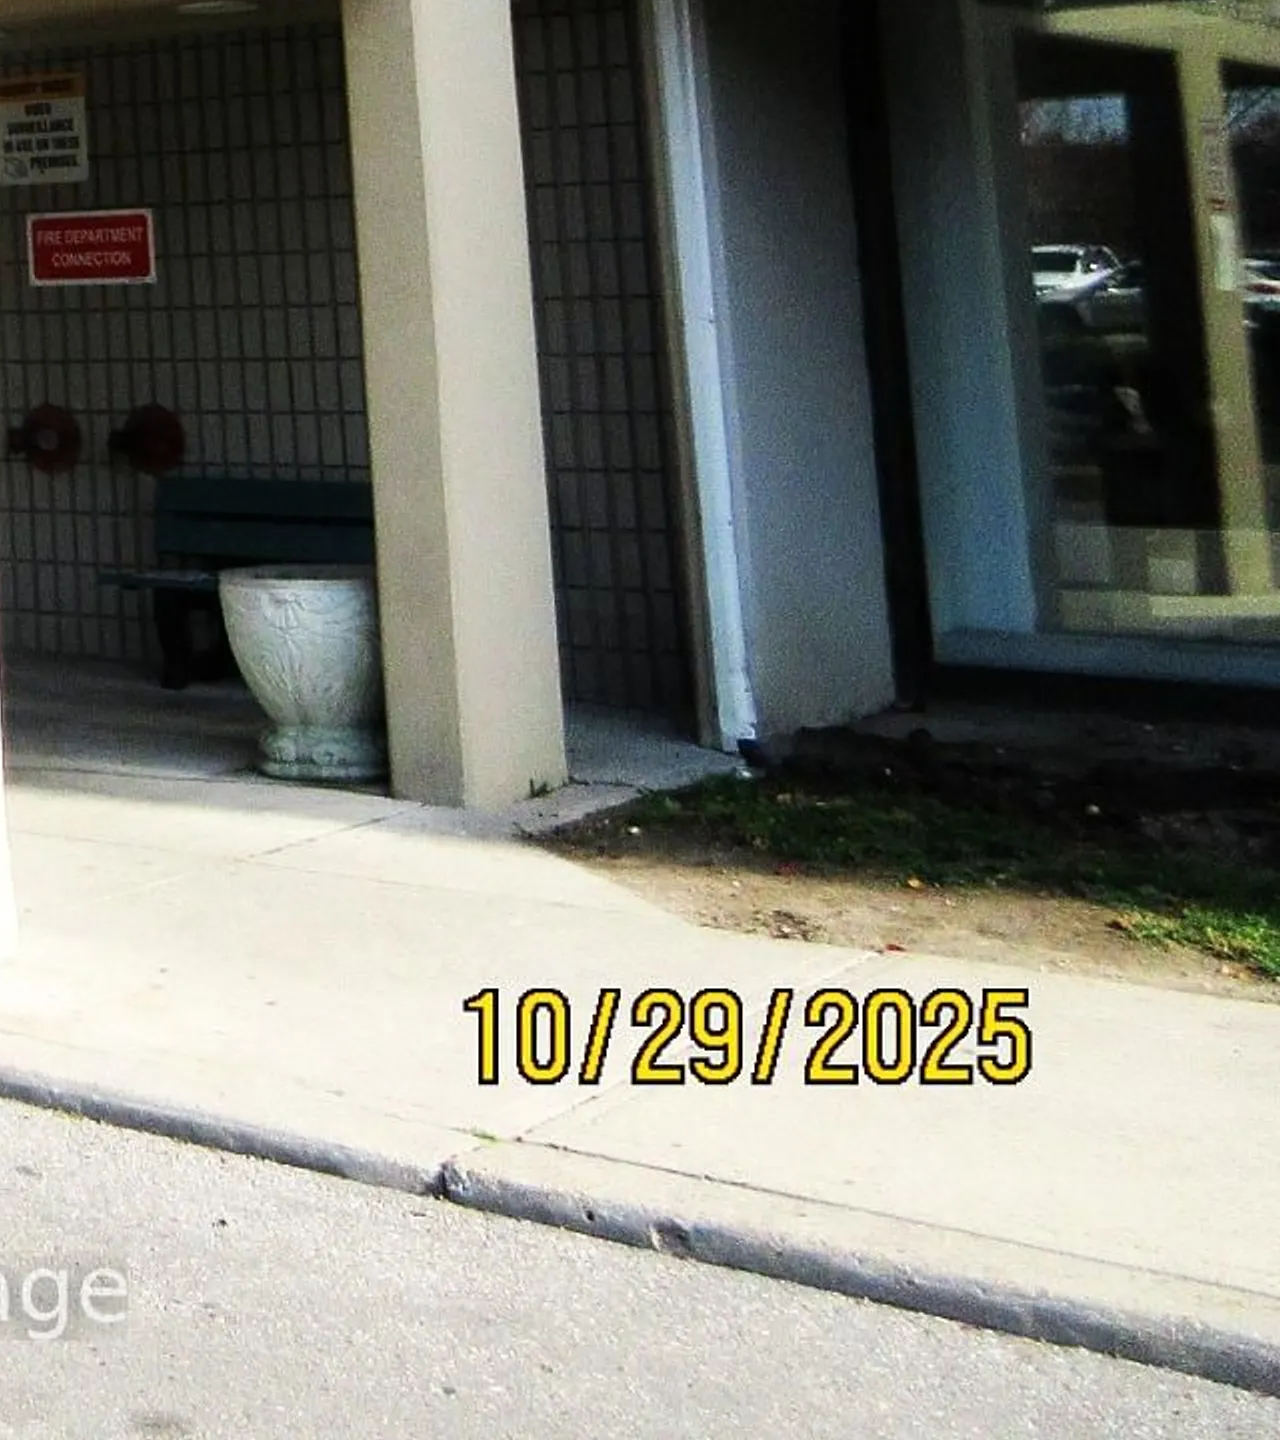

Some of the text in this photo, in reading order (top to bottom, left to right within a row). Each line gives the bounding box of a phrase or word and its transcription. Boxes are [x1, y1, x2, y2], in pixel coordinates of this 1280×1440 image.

[37, 226, 144, 247] FIRE DEPARTMENT
[51, 251, 132, 268] CONNECTION
